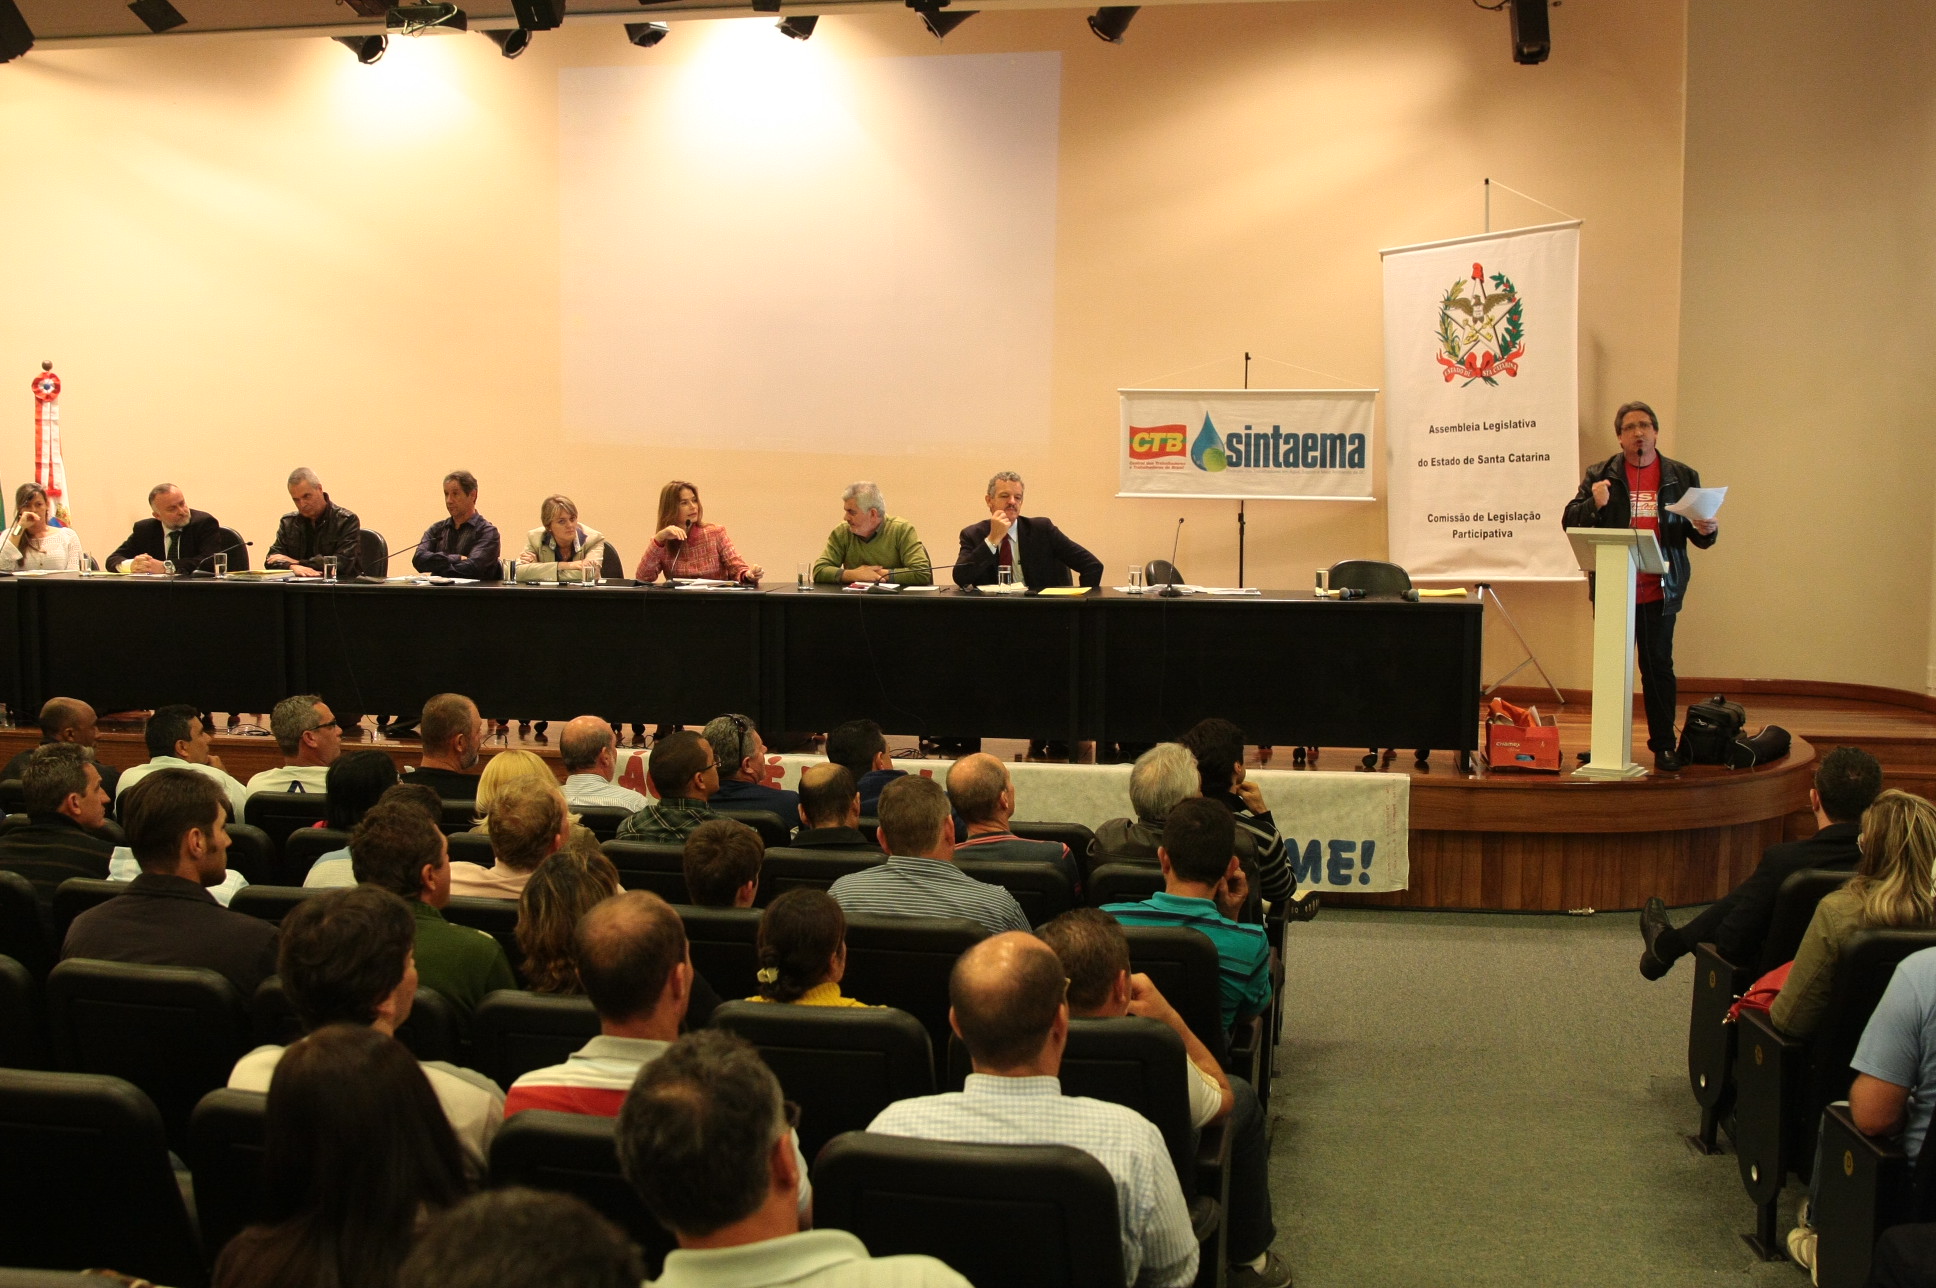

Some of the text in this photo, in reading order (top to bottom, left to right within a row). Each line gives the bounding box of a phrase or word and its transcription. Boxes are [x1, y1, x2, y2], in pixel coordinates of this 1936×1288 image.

[1429, 419, 1537, 434] Assembleia Legislativa
[1132, 431, 1184, 453] CTB
[1226, 424, 1366, 469] sintaema
[1417, 452, 1550, 467] do Estado de Santa Catarina
[1427, 511, 1541, 523] Comissão de Legislação
[1452, 528, 1513, 541] Participativa
